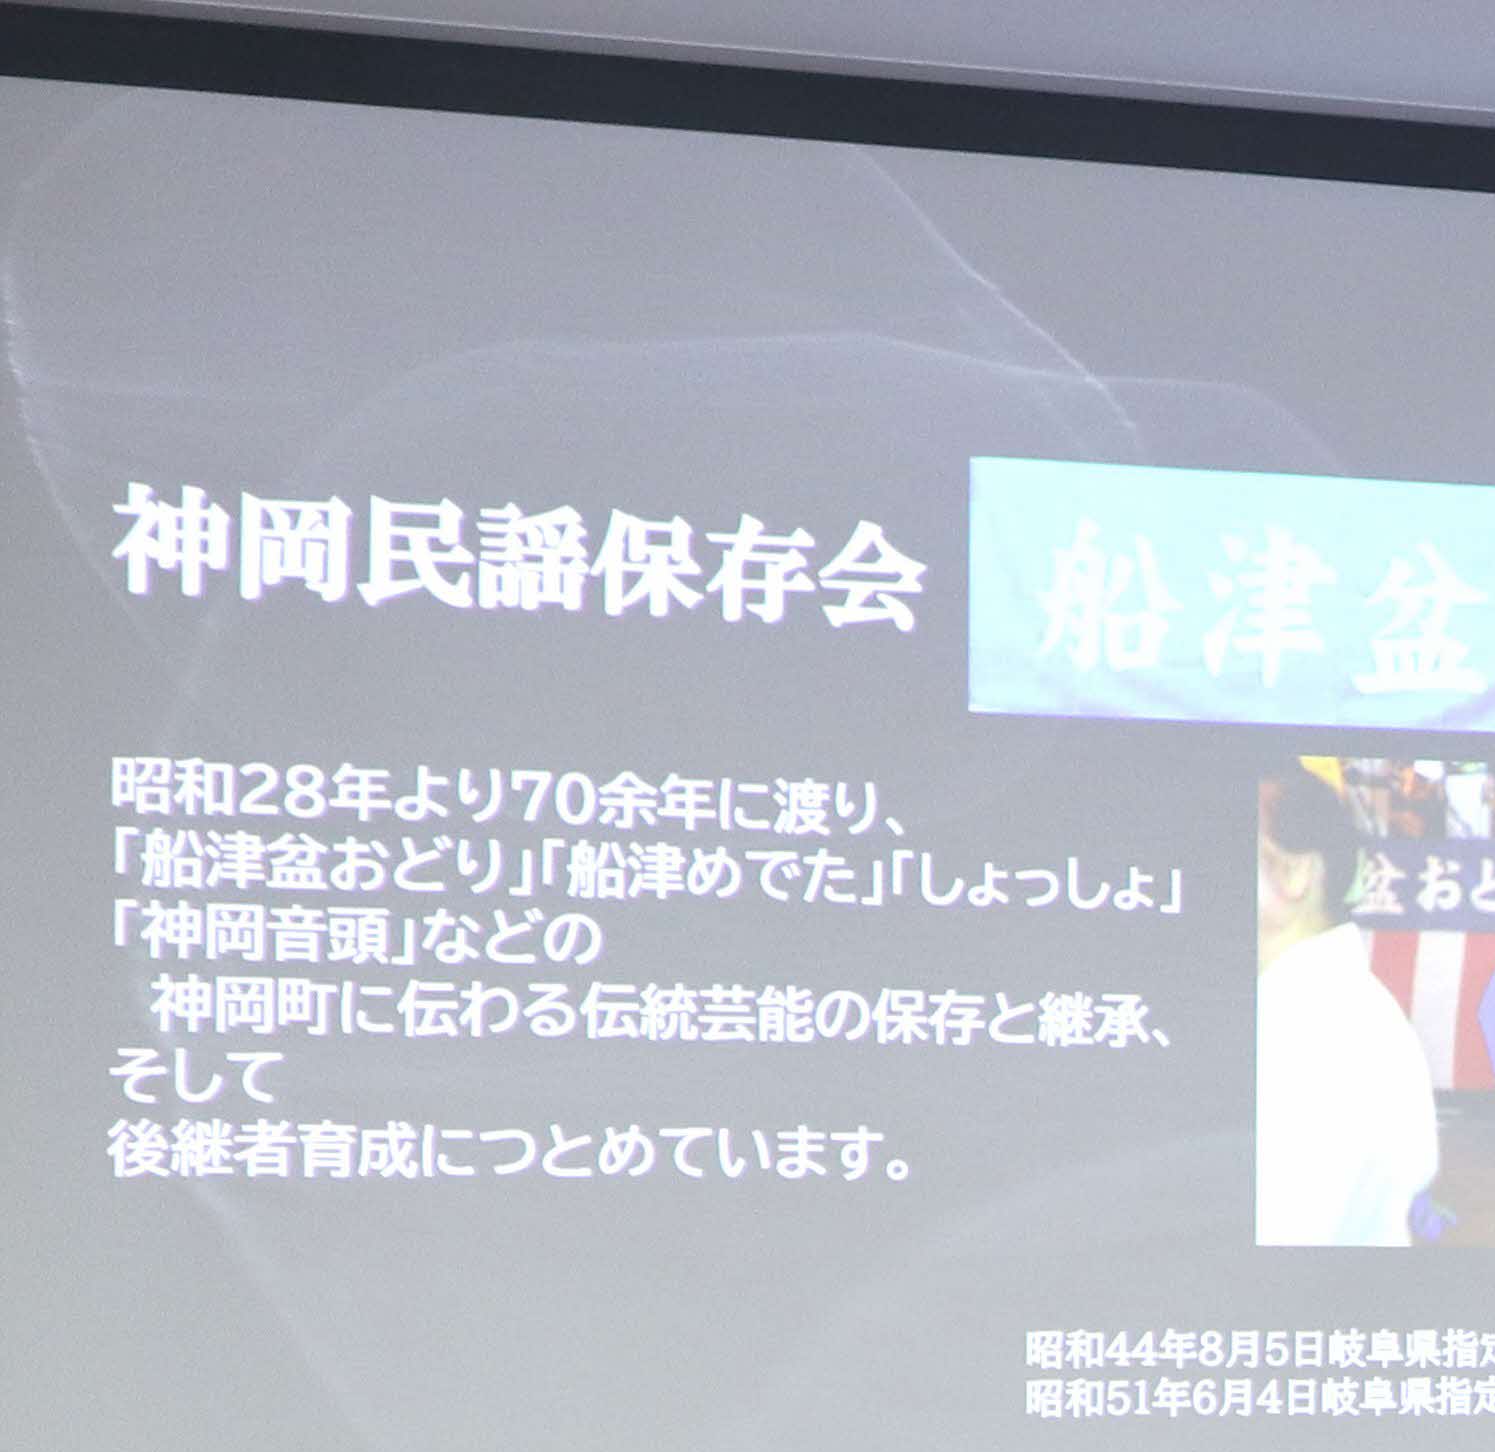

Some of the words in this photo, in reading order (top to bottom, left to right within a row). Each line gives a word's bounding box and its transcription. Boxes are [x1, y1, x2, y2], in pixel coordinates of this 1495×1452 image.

[112, 482, 928, 633] 神岡民謡保存会
[112, 756, 905, 836] 昭和28年より70余年に渡り、
[113, 903, 603, 966] 「神岡音頭」などの
[149, 972, 1172, 1049] 神岡町に伝わる伝統芸能の保存と継承、
[108, 1047, 284, 1104] そして
[107, 1117, 909, 1181] 後継者育成につとめています。
